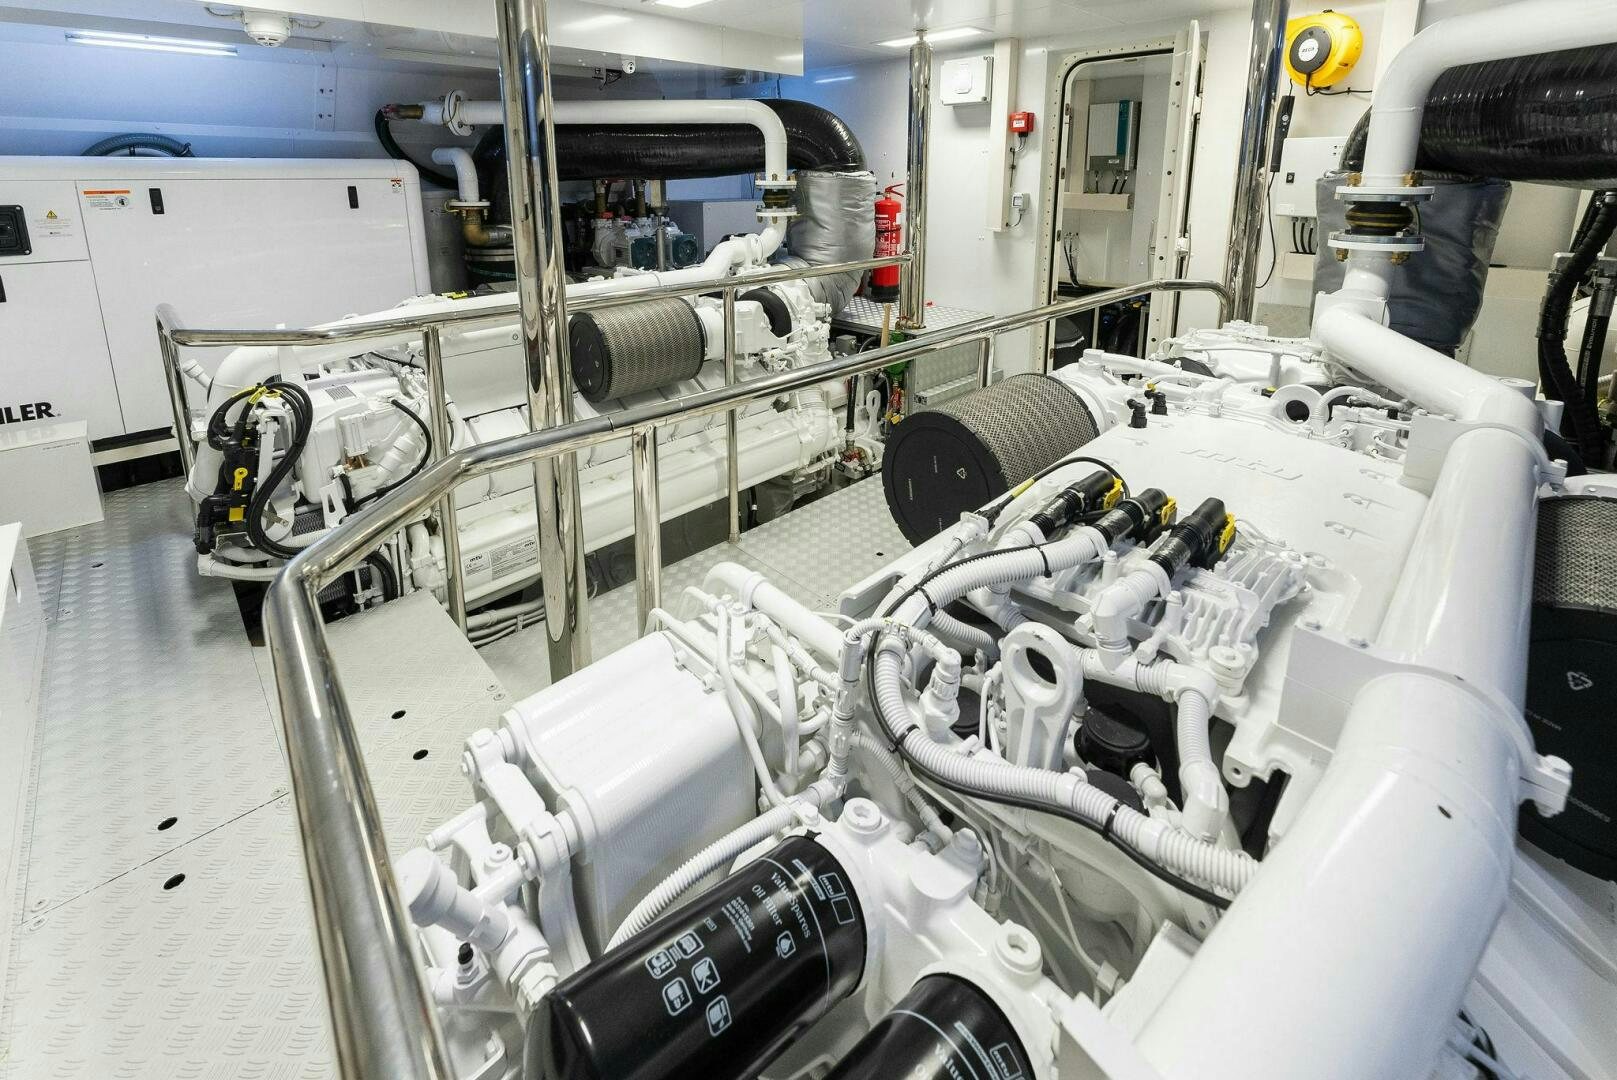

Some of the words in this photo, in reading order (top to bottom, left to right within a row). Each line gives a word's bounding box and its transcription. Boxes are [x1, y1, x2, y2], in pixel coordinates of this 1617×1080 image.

[822, 877, 833, 895] mtu
[752, 885, 766, 898] Oil
[763, 896, 782, 926] Filter
[993, 1050, 1010, 1077] mtu
